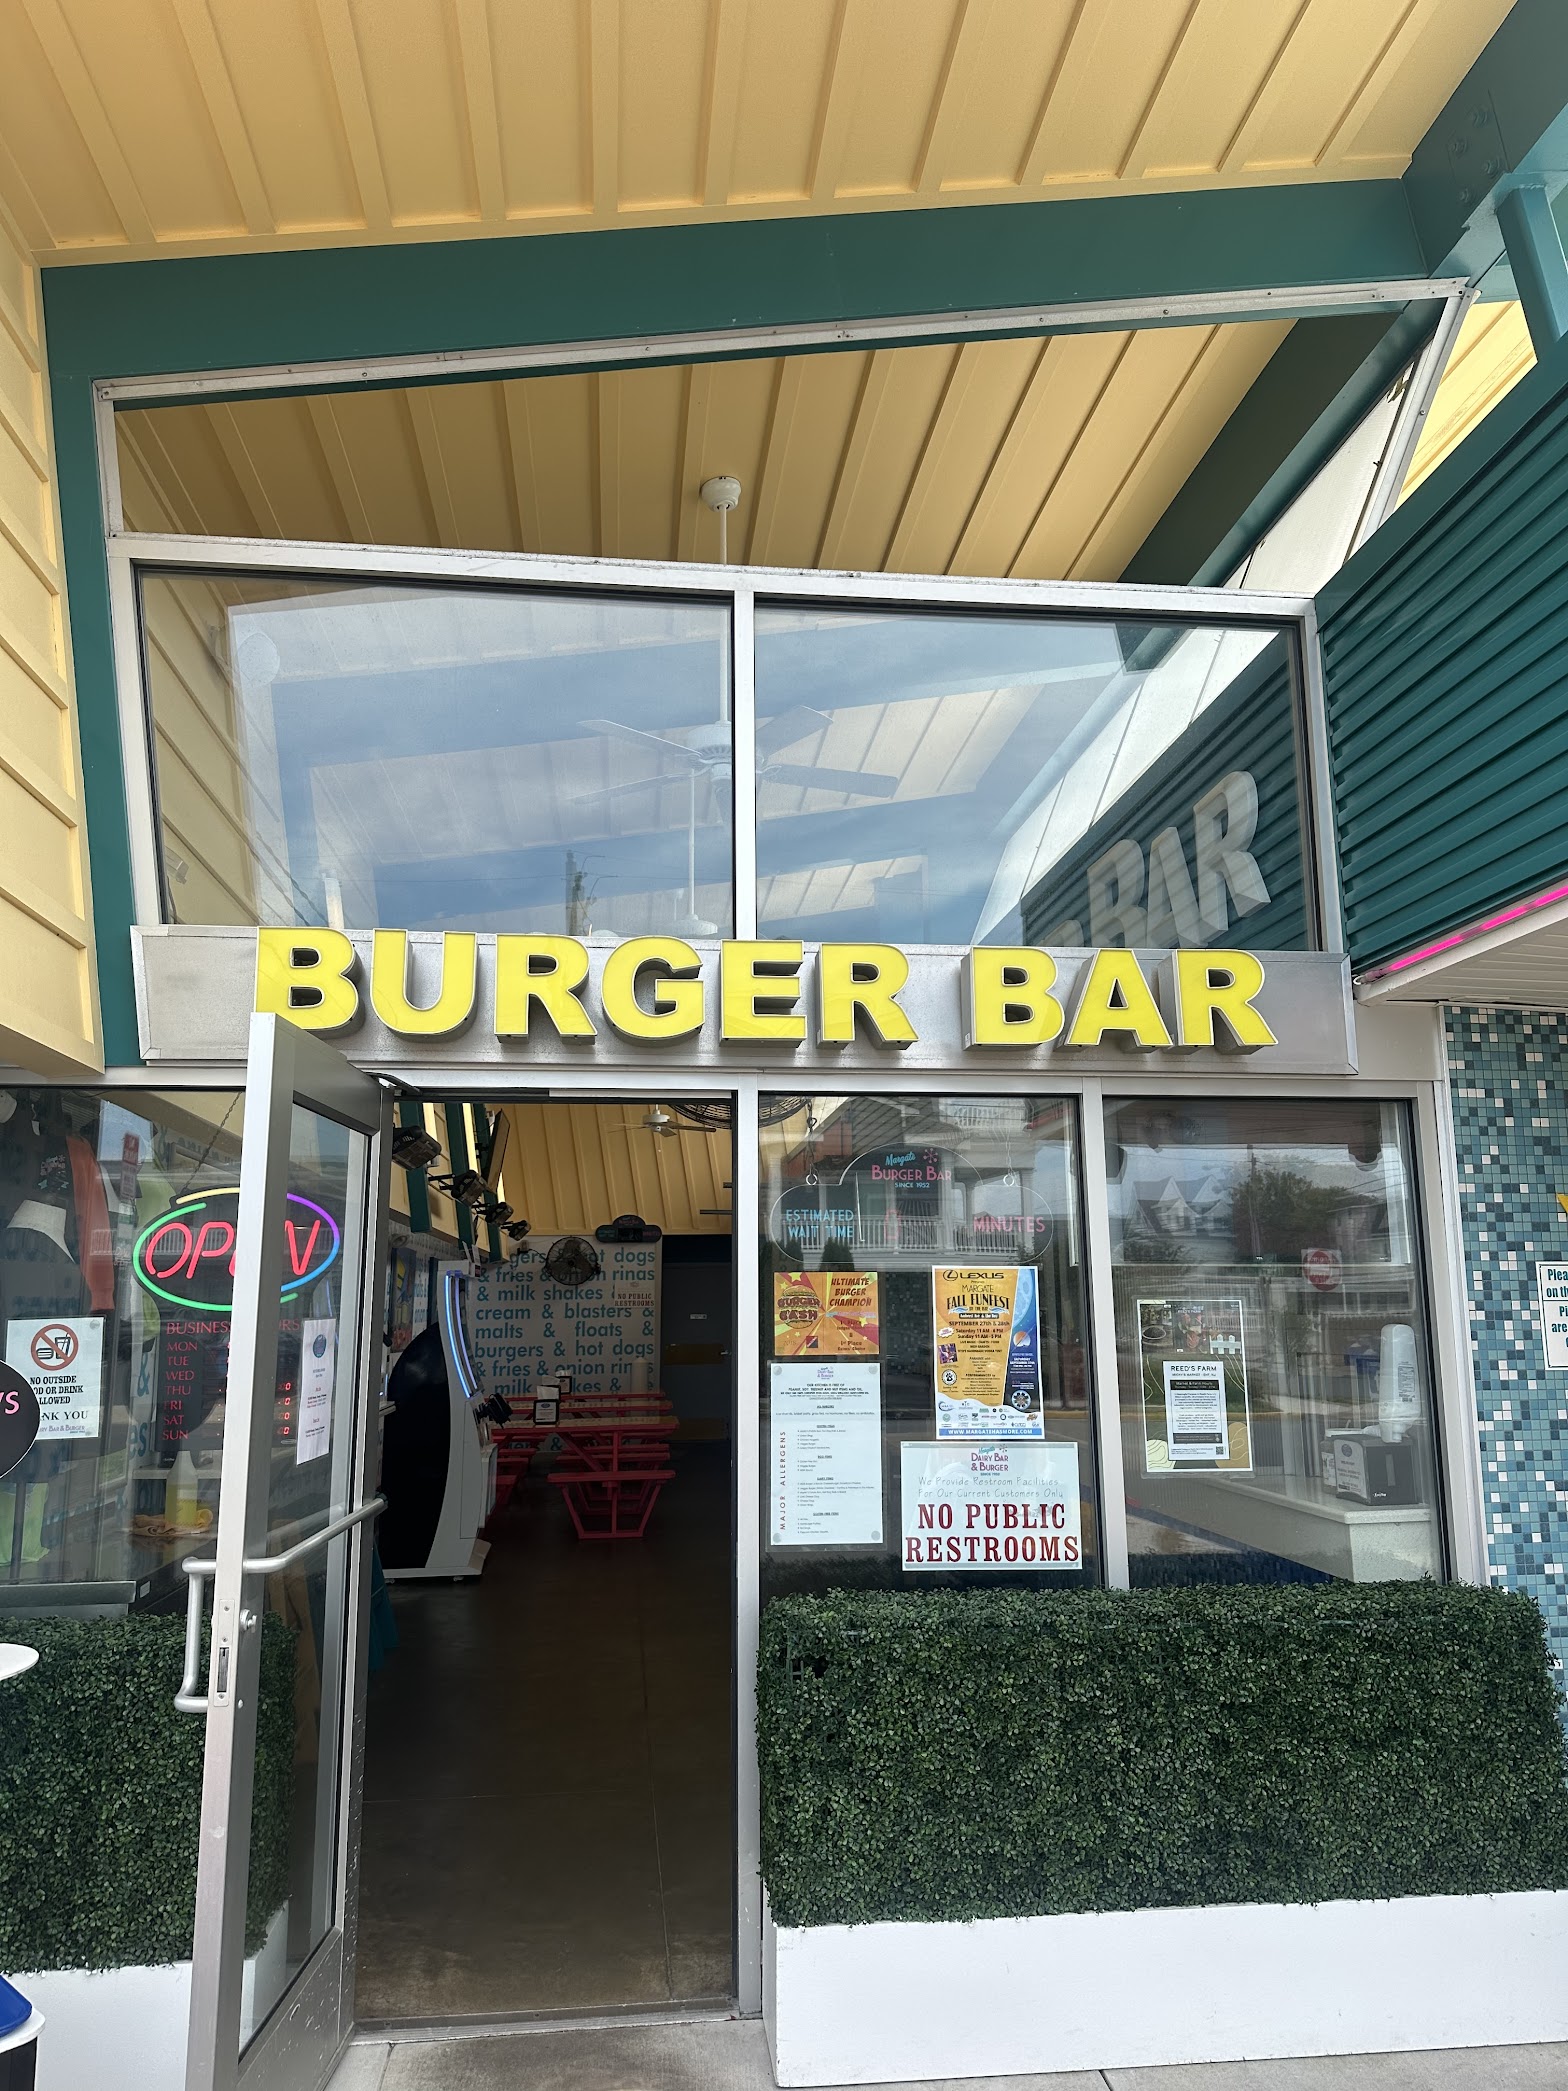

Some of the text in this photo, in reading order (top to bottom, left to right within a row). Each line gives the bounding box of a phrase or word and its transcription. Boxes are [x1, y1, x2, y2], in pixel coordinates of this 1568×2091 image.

[253, 926, 1279, 1050] BURGER BAR
[871, 1165, 952, 1181] BURGER BAR
[786, 1209, 854, 1222] ESTIMATED
[974, 1216, 1045, 1233] MINUTES
[788, 1226, 854, 1238] WAIT TIME
[145, 1220, 321, 1279] OPN
[614, 1247, 655, 1266] dogs
[496, 1266, 534, 1283] fries
[960, 1272, 1004, 1280] LEXUS
[831, 1277, 869, 1286] ULTIMATE
[477, 1286, 489, 1301] &
[498, 1285, 535, 1301] milk
[543, 1284, 603, 1300] shakes
[835, 1288, 866, 1297] BURGER
[962, 1284, 994, 1293] MARGATE
[1546, 1287, 1558, 1298] on
[829, 1298, 872, 1307] CHAMPION
[946, 1293, 1010, 1310] FALL FUNFEST
[475, 1307, 531, 1320] cream
[542, 1304, 554, 1319] &
[565, 1303, 632, 1319] blasters
[475, 1321, 654, 1339] malts & floats &
[1551, 1323, 1568, 1333] are
[167, 1341, 198, 1351] MON
[475, 1339, 654, 1361] burgers & hot dogs
[167, 1356, 189, 1366] TUE
[492, 1360, 531, 1377] fries
[536, 1360, 549, 1376] &
[611, 1357, 654, 1374] rins
[30, 1375, 77, 1385] NO OUTSIDE
[165, 1370, 195, 1381] WED
[46, 1386, 57, 1394] OR
[59, 1385, 84, 1394] DRINK
[610, 1377, 622, 1392] &
[165, 1385, 191, 1396] THU
[39, 1396, 71, 1405] LLOWED
[164, 1400, 182, 1410] FRI
[63, 1411, 89, 1420] YOU
[163, 1415, 184, 1425] SAT
[162, 1430, 190, 1440] SUN
[971, 1453, 1009, 1462] DAIRY BAR
[970, 1462, 1009, 1471] & BURGER
[918, 1476, 932, 1486] We
[936, 1476, 969, 1486] Provide
[973, 1476, 1013, 1486] Restroom
[918, 1488, 1064, 1499] For Our Current Customers Only
[918, 1503, 1066, 1530] NO PUBLIC
[905, 1535, 1079, 1563] RESTROOMS
